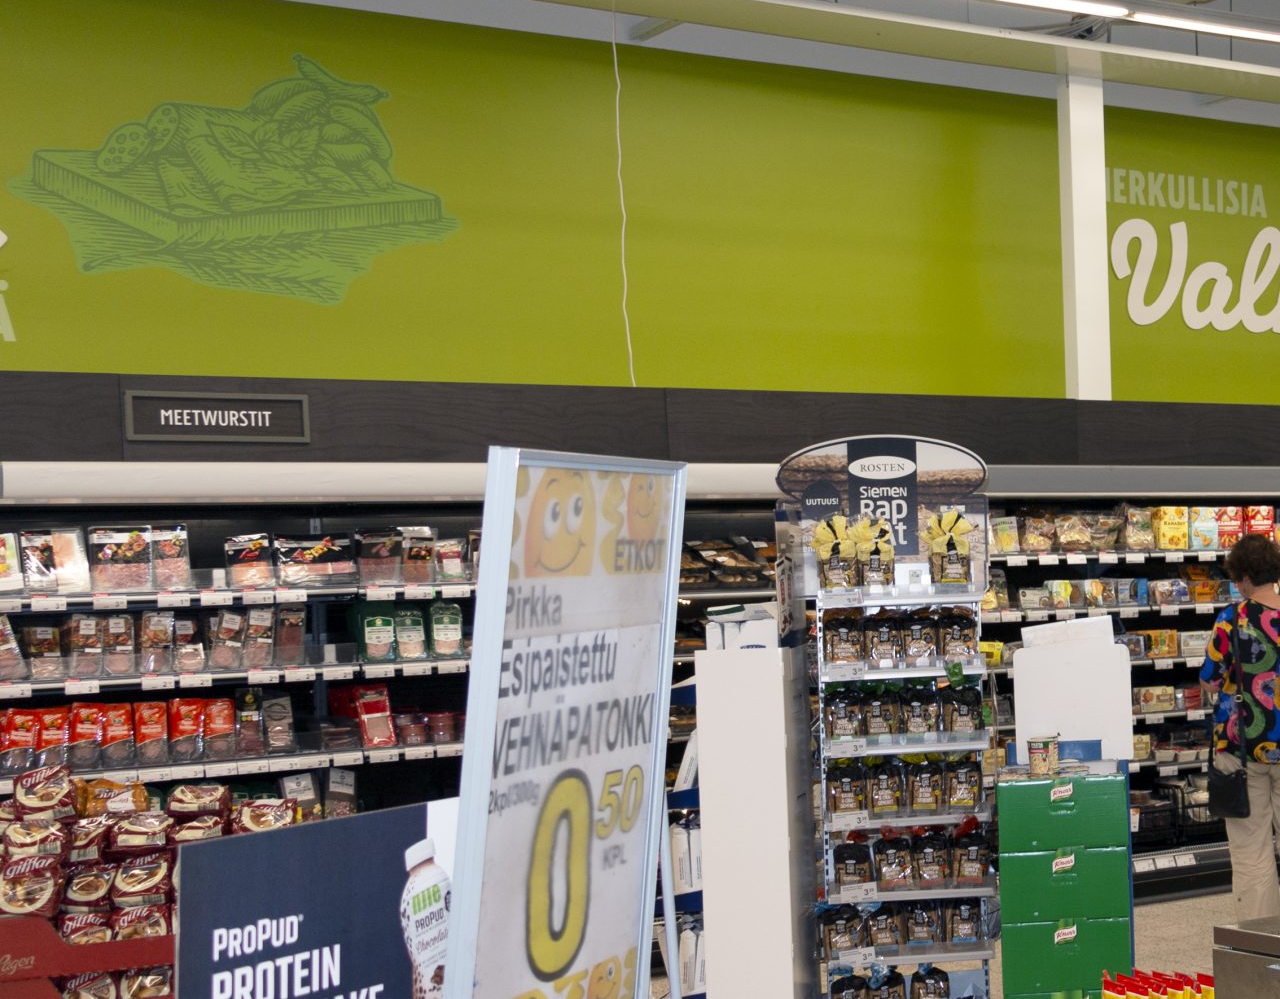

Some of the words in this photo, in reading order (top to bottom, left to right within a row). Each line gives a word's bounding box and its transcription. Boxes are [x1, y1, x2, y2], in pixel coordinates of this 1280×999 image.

[160, 408, 271, 428] MEETWURSTIT
[860, 463, 905, 473] ROSTEN
[613, 539, 664, 572] ETKOT
[498, 632, 618, 708] Esipaistettu
[492, 692, 655, 779] VEHNÄPATONKI
[1053, 787, 1072, 797] Knorr
[6, 856, 54, 878] gifflar
[1054, 857, 1074, 868] Knorr
[526, 768, 593, 982] 0
[595, 765, 644, 840] 50
[1056, 928, 1076, 939] Knorr
